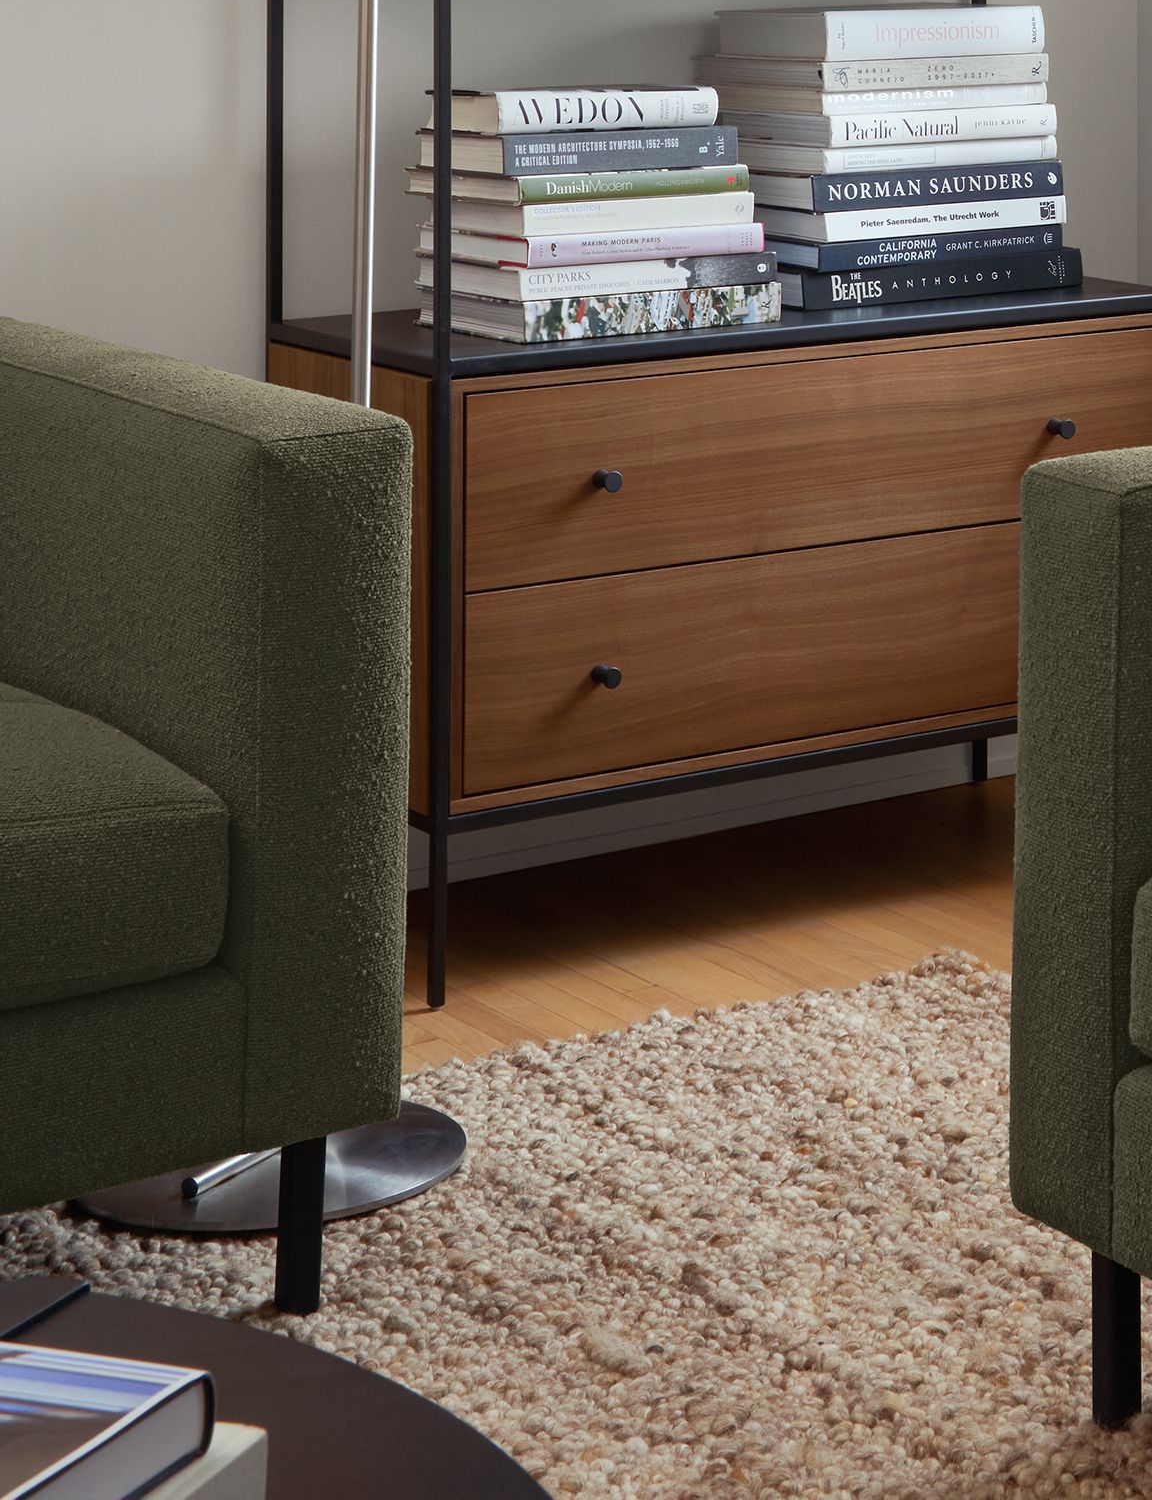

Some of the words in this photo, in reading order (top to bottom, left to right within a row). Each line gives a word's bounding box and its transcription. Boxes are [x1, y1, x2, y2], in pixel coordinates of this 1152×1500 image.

[875, 20, 1001, 48] Impressionism
[857, 67, 891, 75] MARIA
[827, 88, 955, 103] modernism
[844, 118, 897, 141] Pacific
[902, 115, 959, 138] Natural
[514, 144, 527, 154] THE
[528, 143, 556, 154] MODERN
[558, 141, 607, 153] ARCHITECTURE
[609, 139, 645, 151] SYMPOSIA,
[716, 135, 725, 157] Yale
[514, 157, 520, 167] A
[521, 155, 551, 167] CRITICAL
[552, 154, 578, 165] EDITION
[827, 178, 922, 202] NORMAN
[929, 171, 1034, 195] SAUNDERS
[860, 219, 885, 228] Pieter
[886, 215, 931, 227] Saenredam,
[933, 214, 948, 222] The
[949, 211, 978, 221] Utrecht
[979, 210, 1000, 219] Work
[641, 236, 661, 244] PARIS
[878, 238, 938, 252] CALIFORNIA
[945, 241, 973, 252] GRANT
[974, 240, 983, 249] C.
[983, 234, 1035, 248] KIRKPATRICK
[856, 250, 938, 266] CONTEMPORARY
[528, 273, 555, 285] CITY
[556, 270, 591, 283] PARKS
[849, 271, 862, 280] THE
[528, 286, 550, 294] PUBLIC
[573, 283, 597, 291] PRIVATE
[830, 274, 883, 304] BEATLES
[891, 269, 1013, 290] ANTHOLOGY
